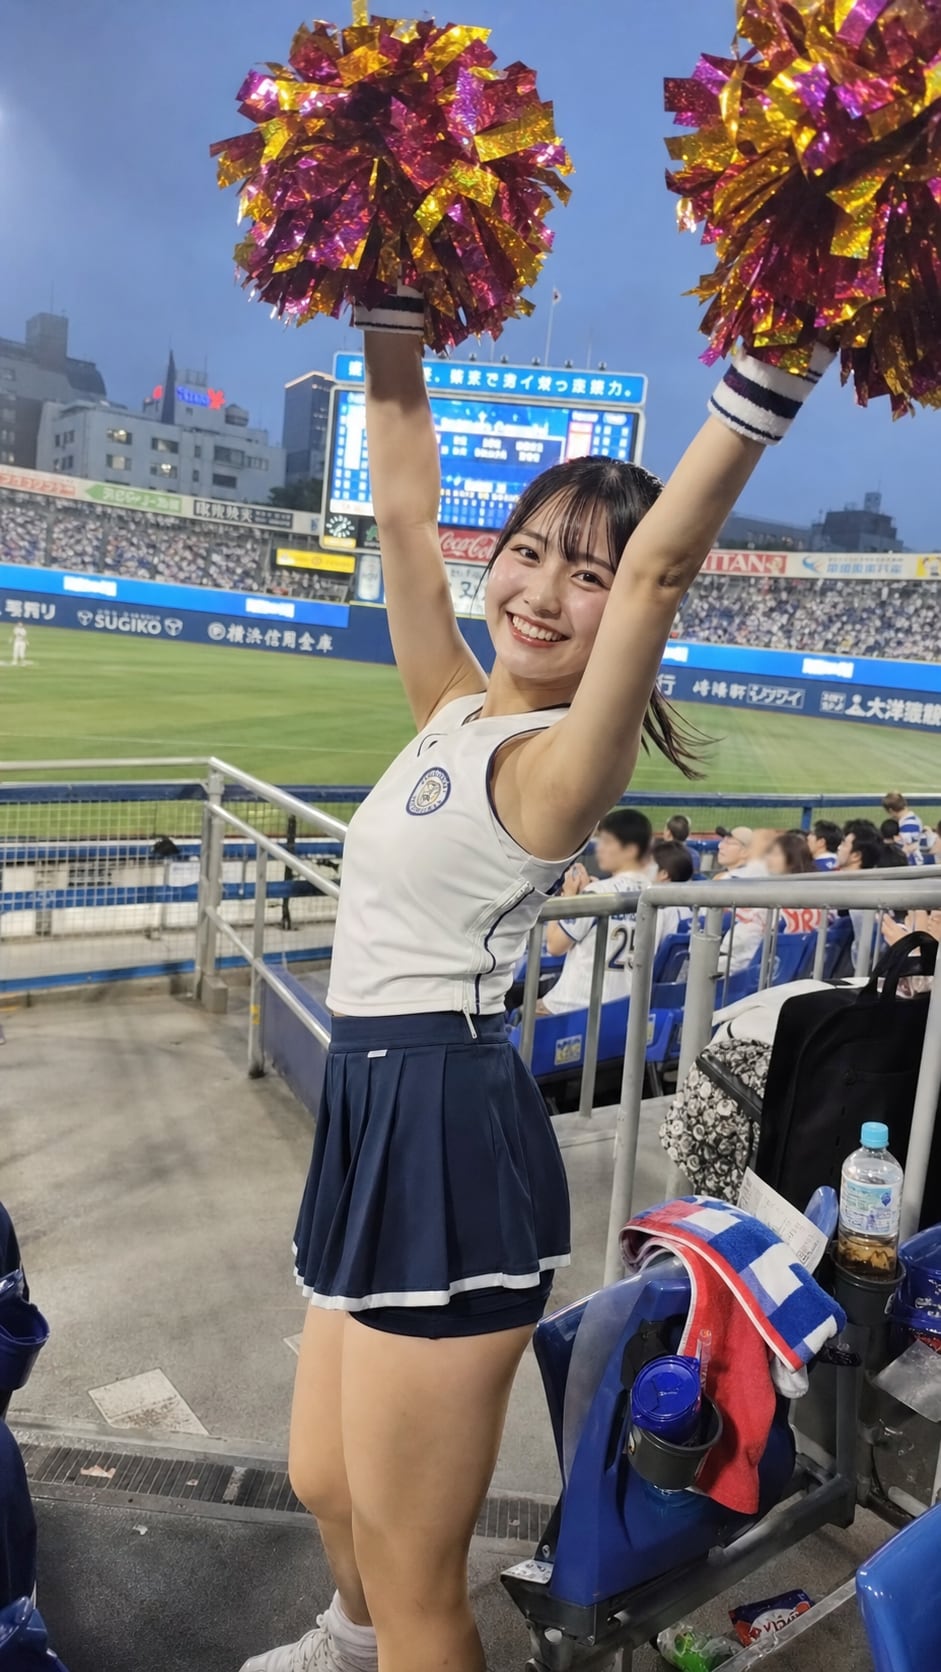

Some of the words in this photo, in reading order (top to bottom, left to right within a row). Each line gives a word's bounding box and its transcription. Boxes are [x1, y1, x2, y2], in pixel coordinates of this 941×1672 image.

[95, 614, 162, 635] SUGIKO
[227, 623, 333, 653] 横浜信用金庫
